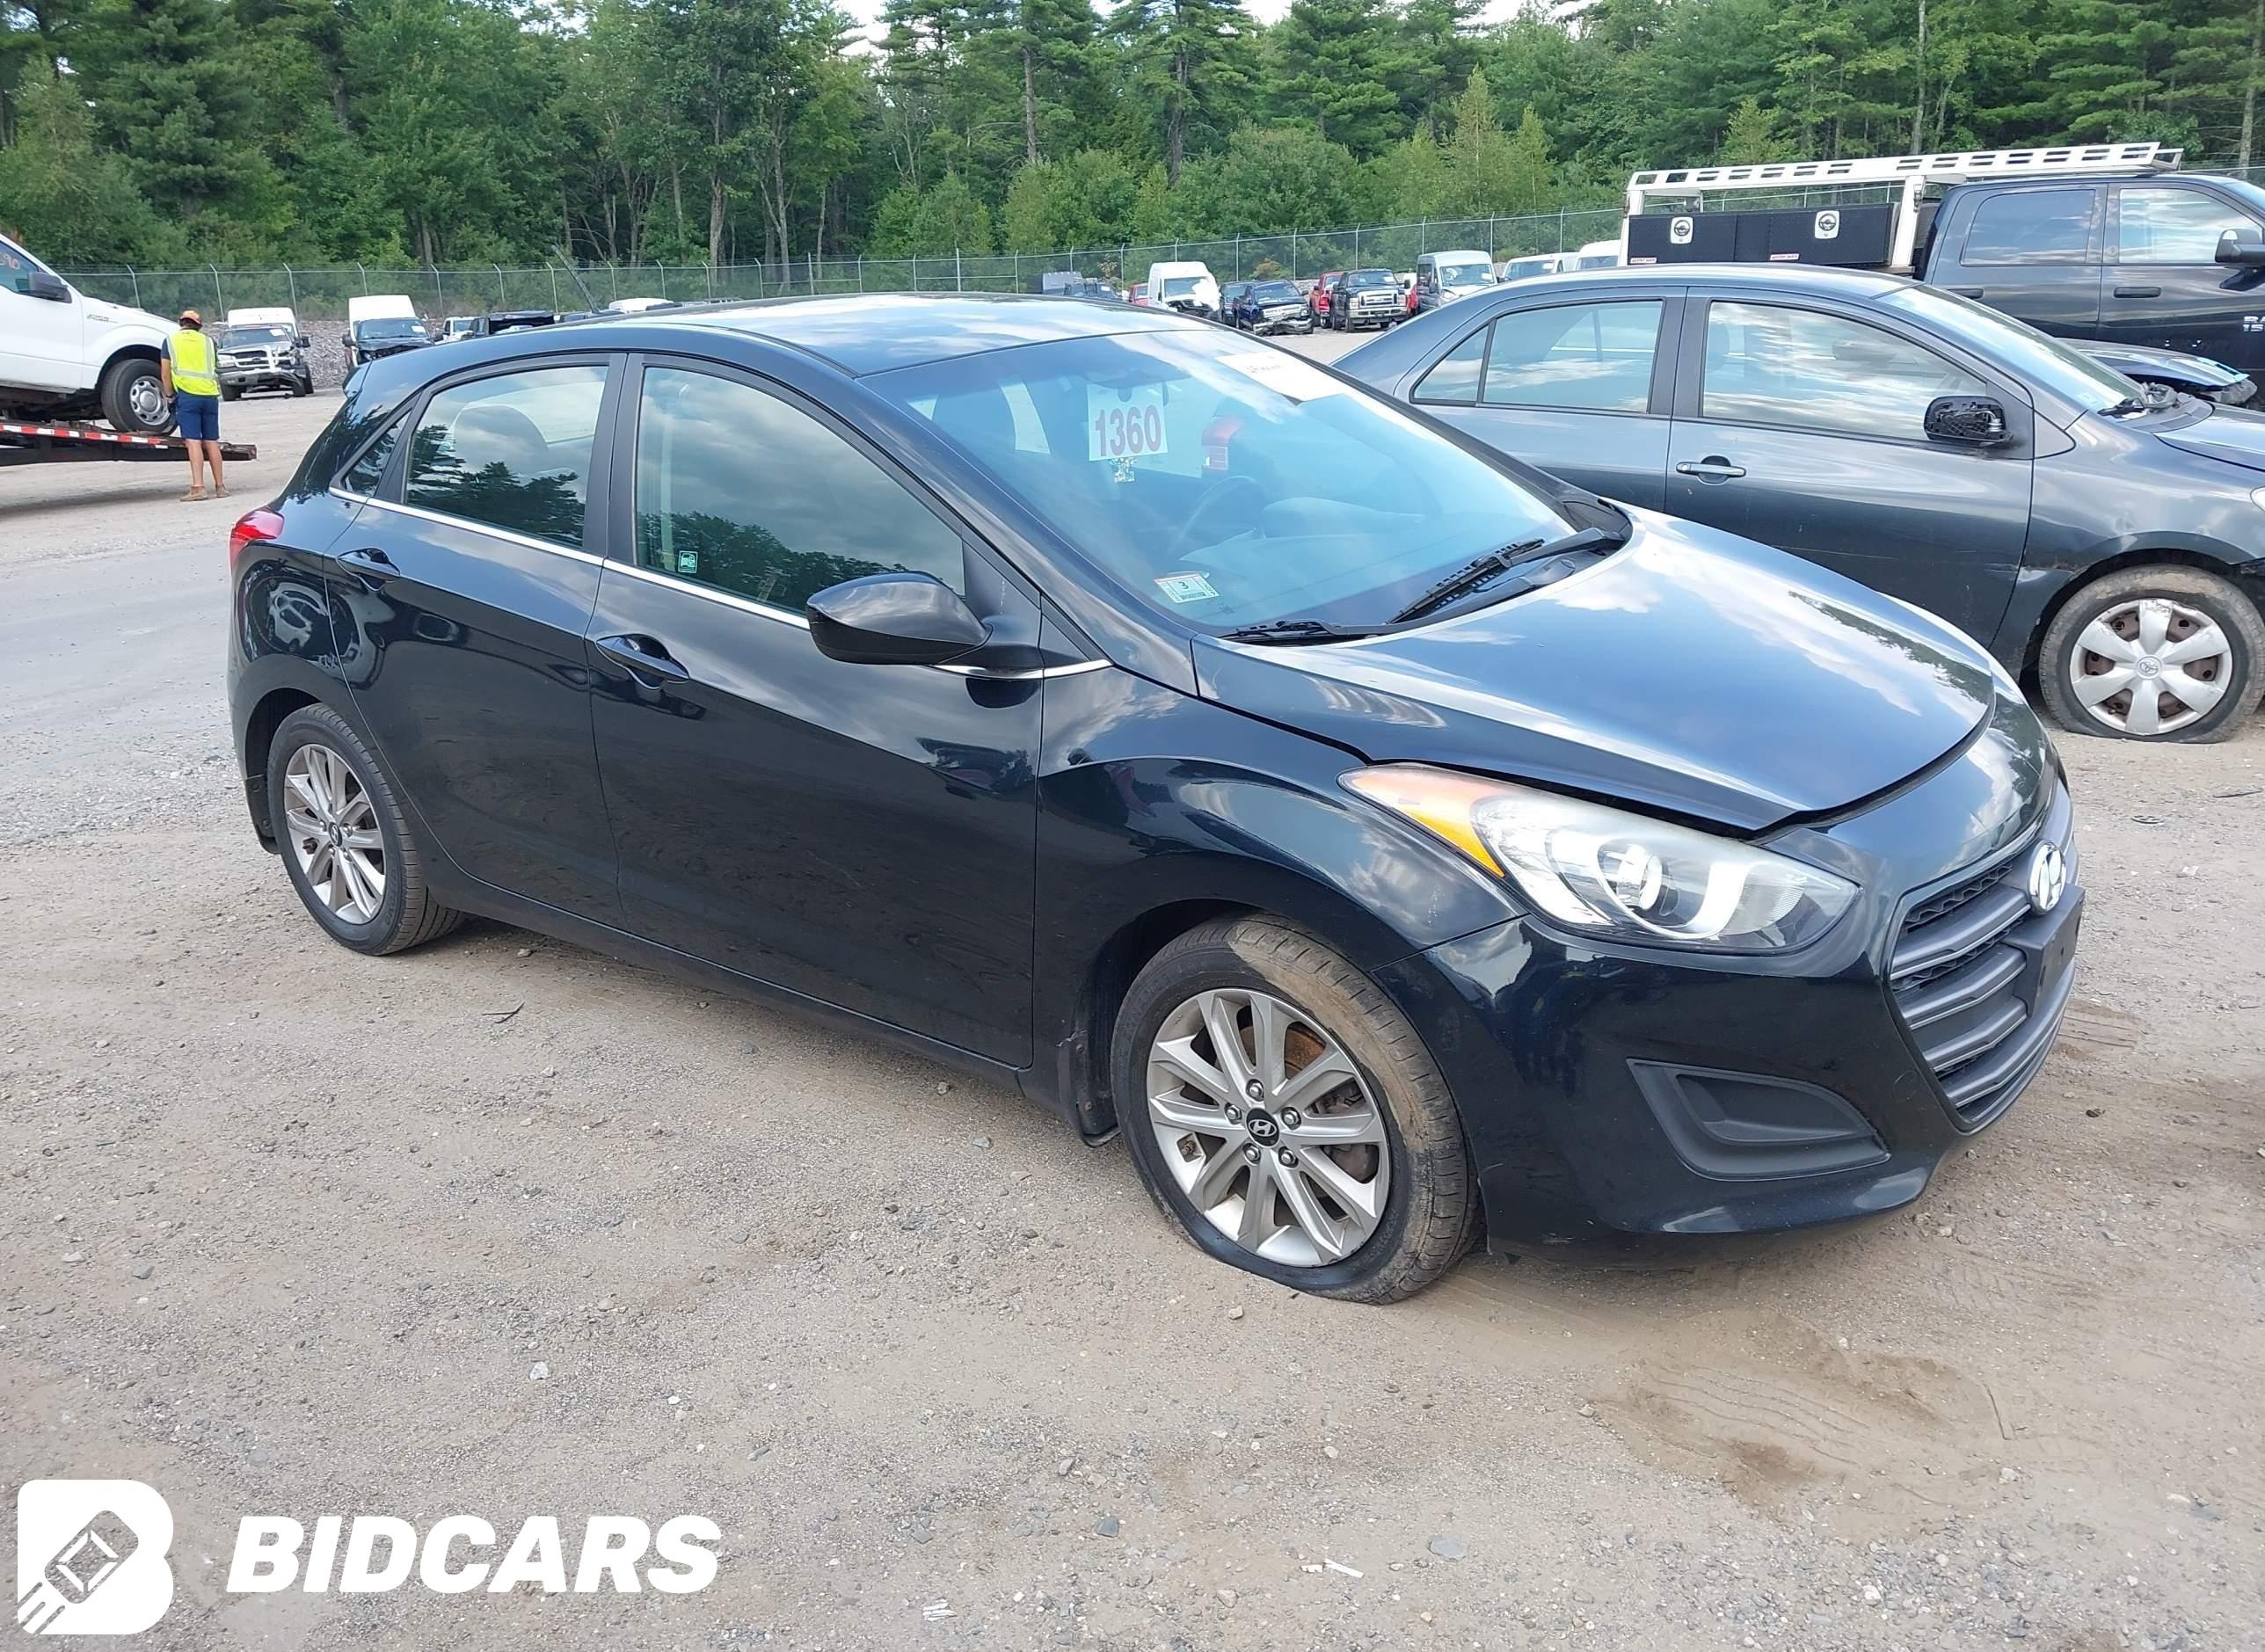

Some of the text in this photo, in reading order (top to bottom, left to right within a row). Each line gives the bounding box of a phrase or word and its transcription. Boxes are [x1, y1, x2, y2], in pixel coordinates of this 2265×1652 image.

[2243, 324, 2265, 332] 15
[1095, 404, 1162, 457] 1360
[1178, 581, 1190, 590] 3
